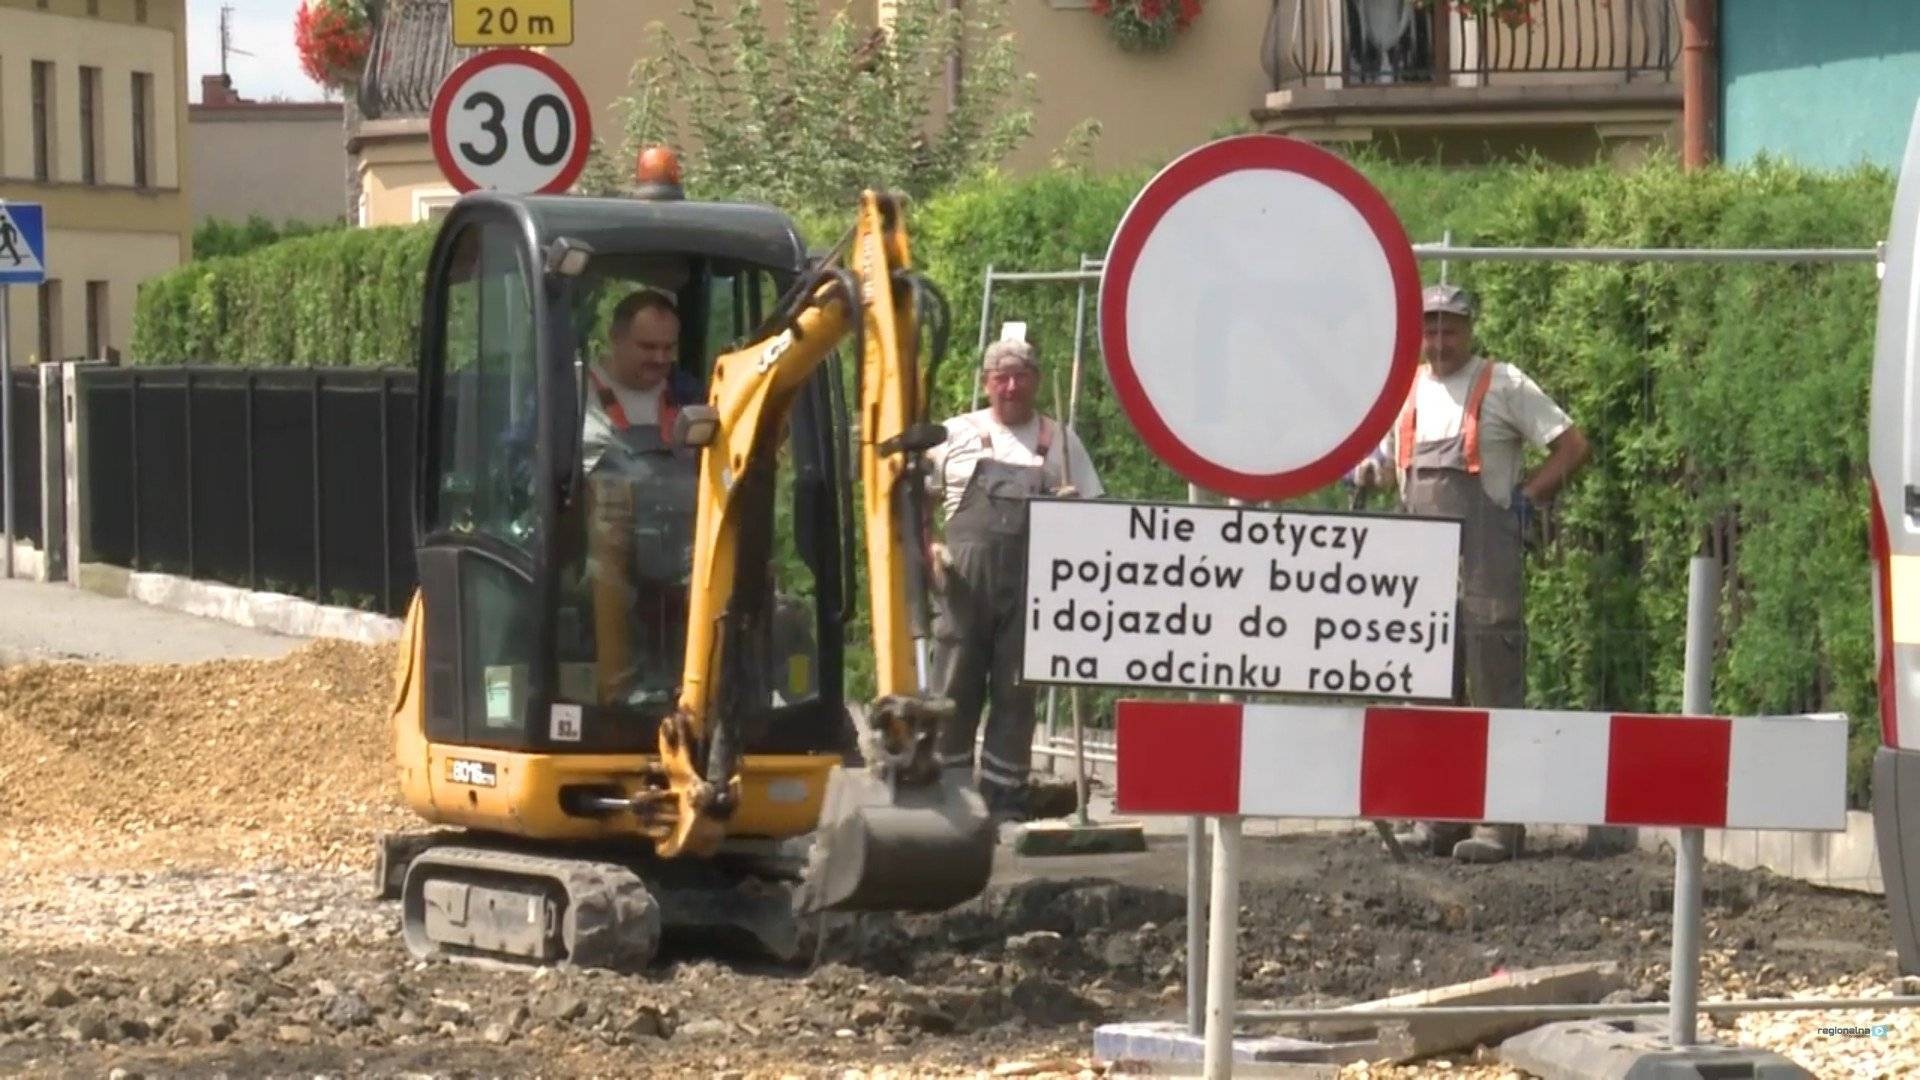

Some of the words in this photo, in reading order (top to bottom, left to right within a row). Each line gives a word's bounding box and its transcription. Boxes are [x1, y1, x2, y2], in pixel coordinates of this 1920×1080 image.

[477, 6, 518, 35] 20
[527, 15, 554, 35] m
[459, 90, 571, 167] 30
[1129, 506, 1195, 543] Nie
[1220, 509, 1369, 560] dotyczy
[1050, 550, 1244, 593] pojazdów
[1269, 558, 1419, 609] budowy
[1032, 597, 1041, 632] i
[1053, 598, 1212, 643] dojazdu
[1239, 604, 1288, 639] do
[1314, 611, 1450, 653] posesji
[1050, 654, 1098, 680] na
[1125, 650, 1281, 688] odcinku
[1308, 659, 1413, 695] robót
